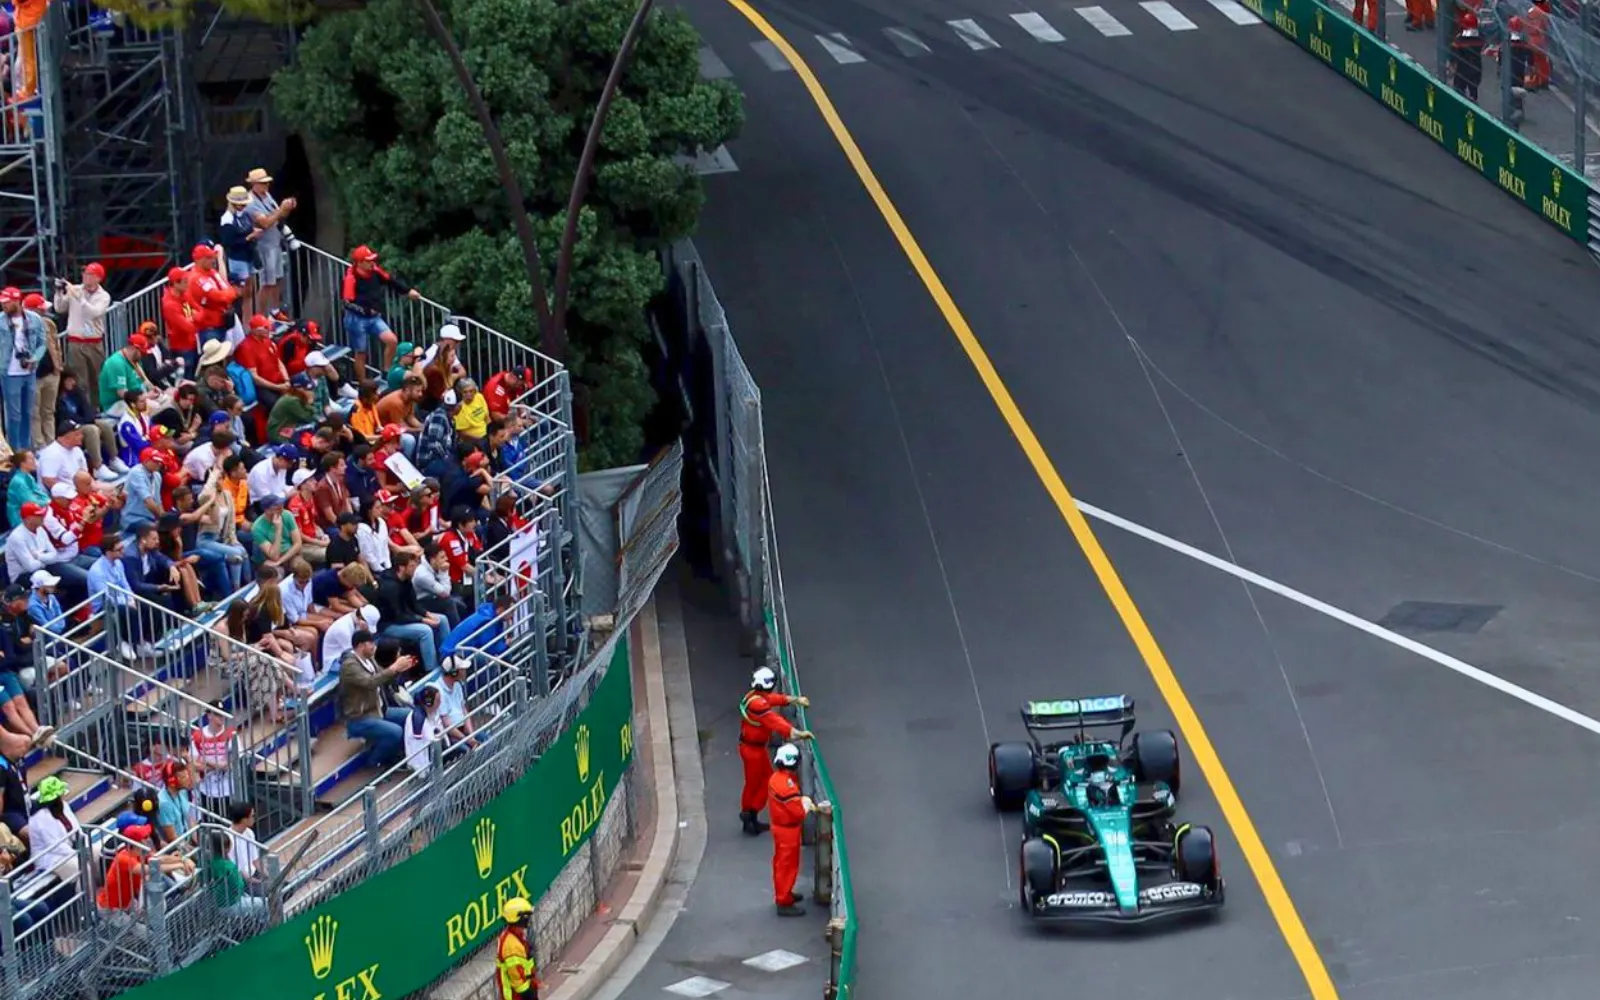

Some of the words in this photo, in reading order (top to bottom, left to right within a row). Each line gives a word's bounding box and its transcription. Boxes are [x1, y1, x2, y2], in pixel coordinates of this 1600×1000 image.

[1275, 10, 1298, 38] ROLEX
[1310, 33, 1332, 62] ROLEX
[1345, 57, 1368, 87] ROLEX
[1382, 83, 1405, 115] ROLEX
[1419, 110, 1444, 143] ROLEX
[1457, 137, 1484, 172] ROLEX
[1499, 166, 1526, 200] ROLEX
[1542, 195, 1572, 231] ROLEX
[1035, 697, 1117, 714] aramco
[1047, 892, 1103, 906] aramco
[1148, 883, 1201, 900] aramco
[446, 864, 531, 957] ROLEX
